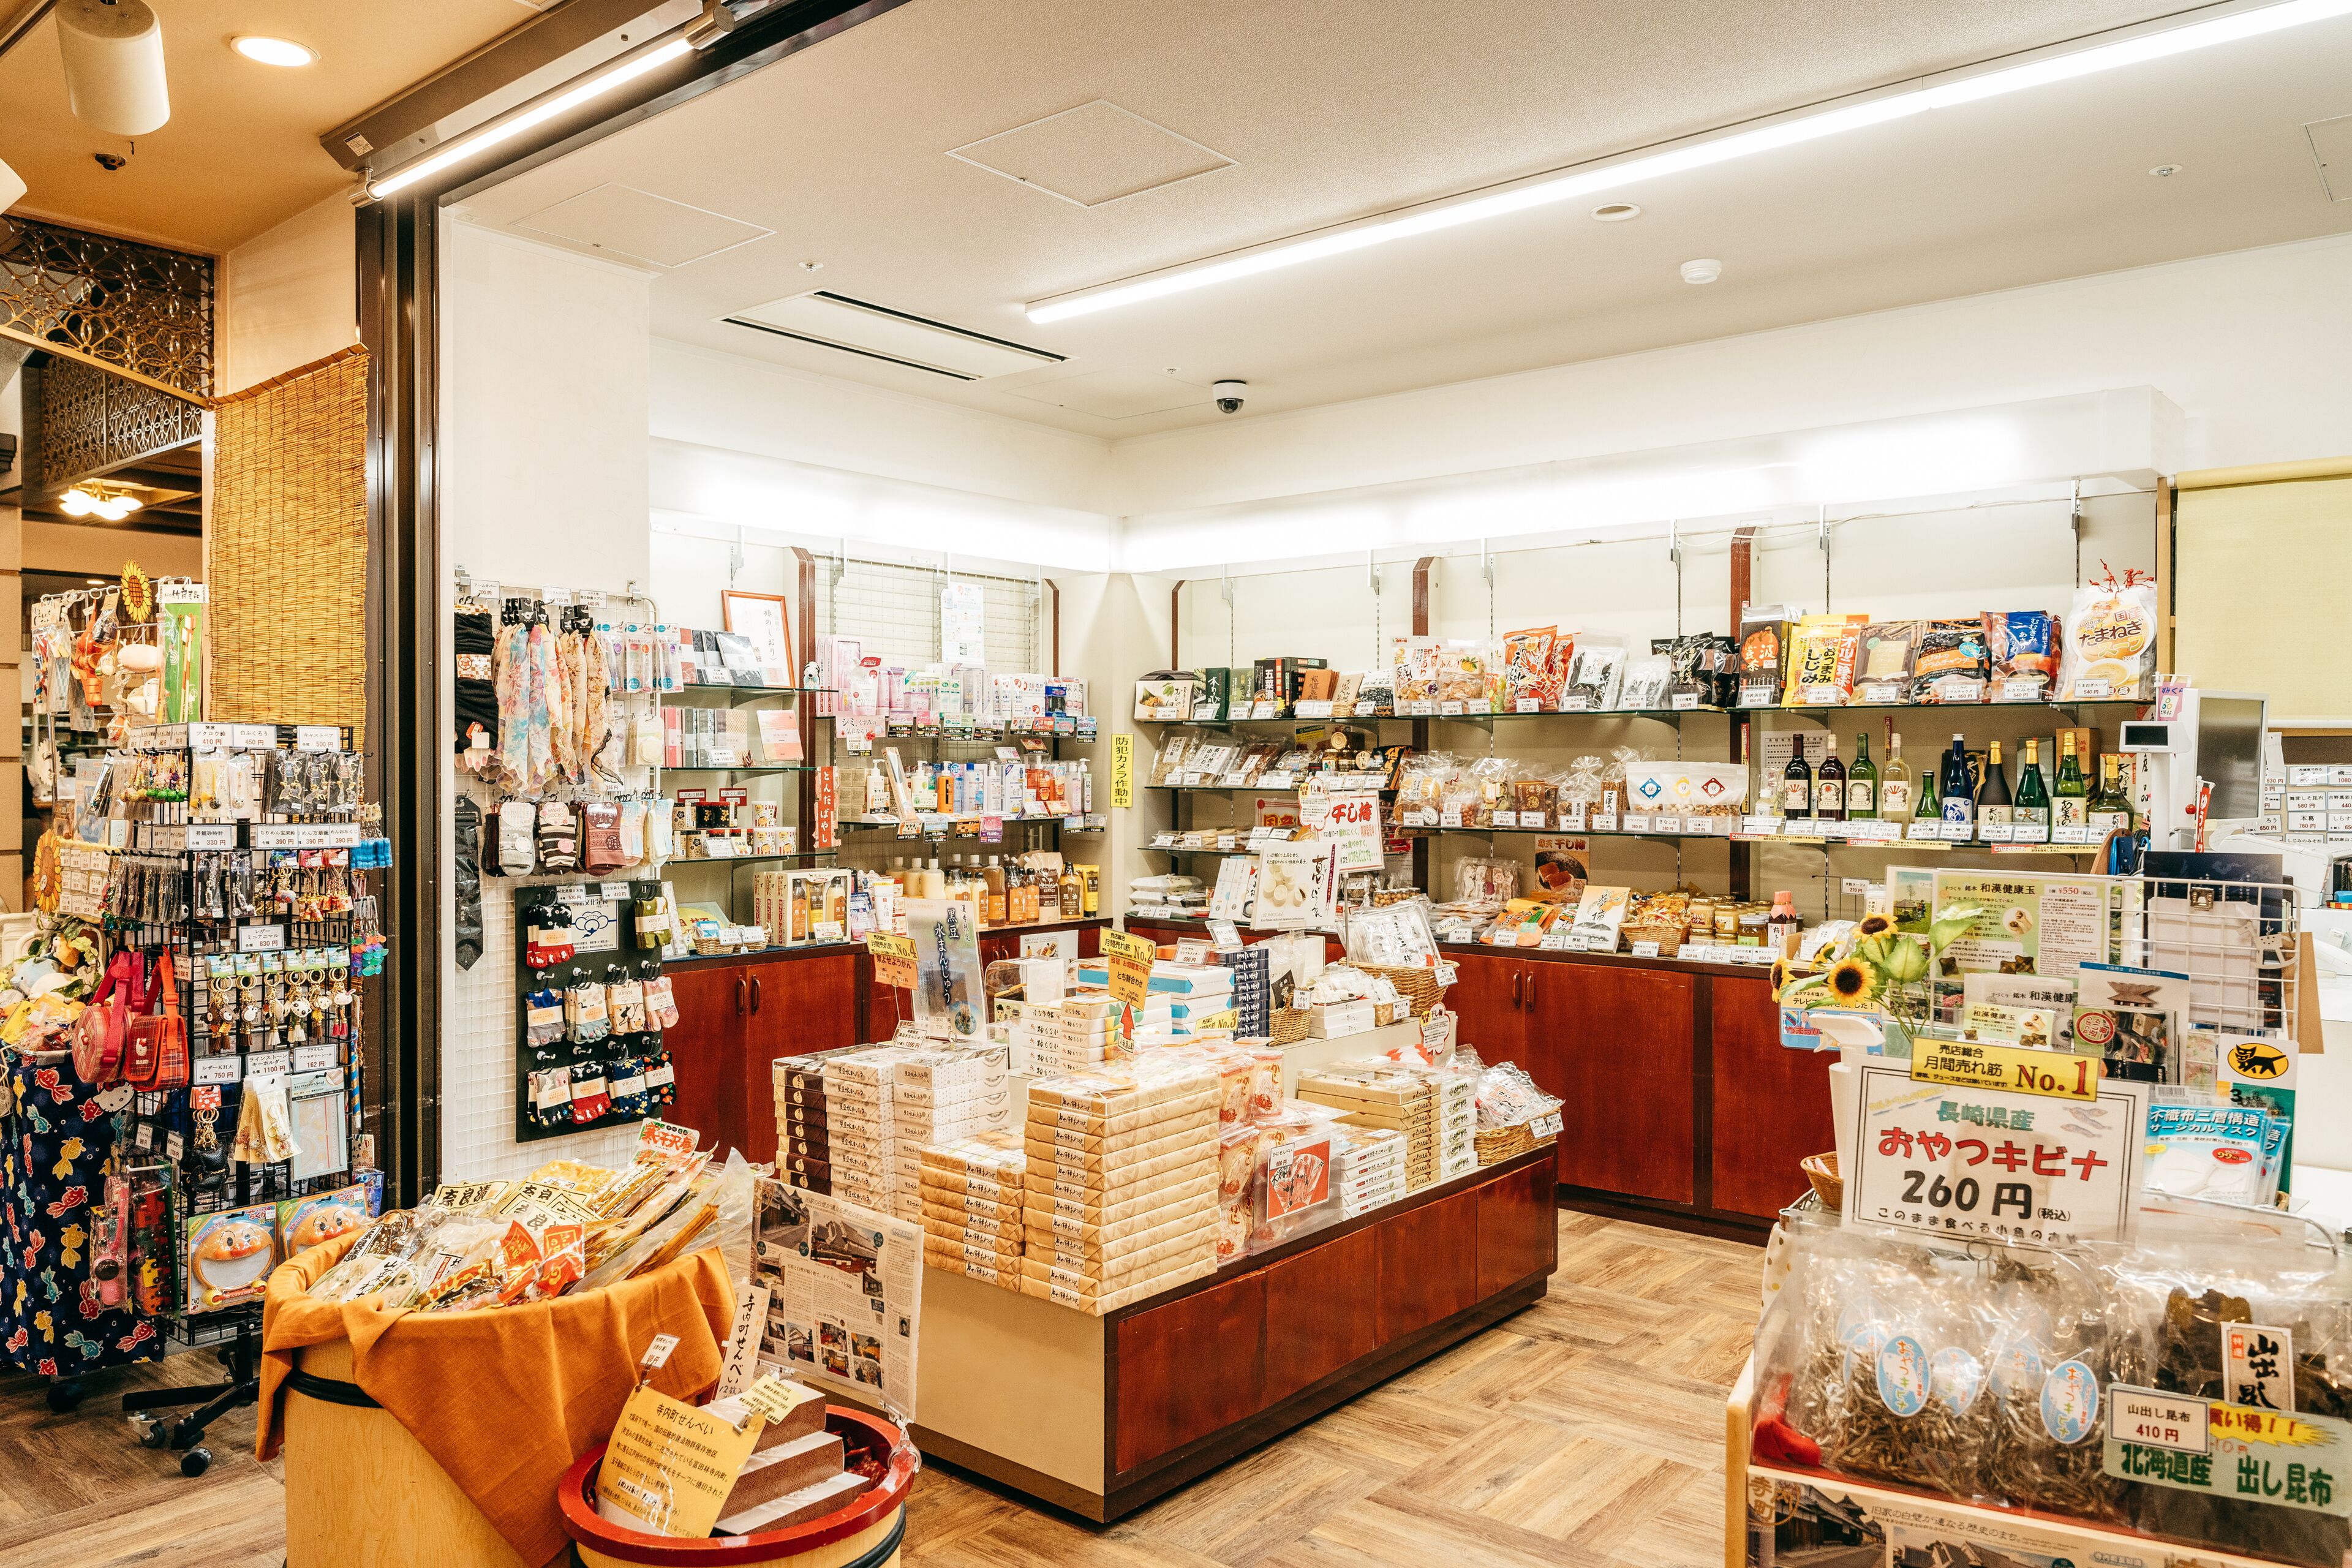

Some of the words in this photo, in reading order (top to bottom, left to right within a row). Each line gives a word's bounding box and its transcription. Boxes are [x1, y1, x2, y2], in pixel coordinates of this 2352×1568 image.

[2113, 606, 2143, 622] 国産
[2079, 619, 2143, 648] たまねぎ
[2098, 635, 2146, 658] スープ
[1115, 737, 1128, 804] 防犯カメラ作動中
[821, 770, 832, 842] とんだばやし
[1332, 802, 1372, 824] 干し梅
[1981, 884, 2035, 894] 和漢健康玉
[946, 908, 959, 939] 黒豆
[872, 940, 892, 950] 月間売れ筋
[895, 941, 917, 959] No.4
[1105, 939, 1130, 951] 月間売れ筋
[1134, 944, 1153, 964] No.2
[935, 923, 952, 1003] 水まんじゅう
[1117, 971, 1143, 988] とち餅合わせ
[1973, 1011, 2016, 1020] 和漢健康玉
[1939, 1044, 1983, 1058] 売店総合
[1924, 1056, 2003, 1076] 月間売れ筋
[2016, 1060, 2089, 1095] No.1
[1937, 1101, 2035, 1131] 長崎県産
[2150, 1109, 2260, 1128] 不織布三層構造
[2149, 1123, 2257, 1137] サージカルマスク
[1878, 1126, 2108, 1181] おやつキビナ
[442, 1186, 491, 1207] 奈良漬
[1902, 1170, 1979, 1211] 260
[728, 1292, 755, 1384] 寺内町せんべい
[657, 1403, 713, 1435] 寺内町せんべい
[2128, 1404, 2190, 1422] 山出し昆布
[2122, 1444, 2212, 1486] 北海道産
[2237, 1455, 2334, 1507] 出し昆布
